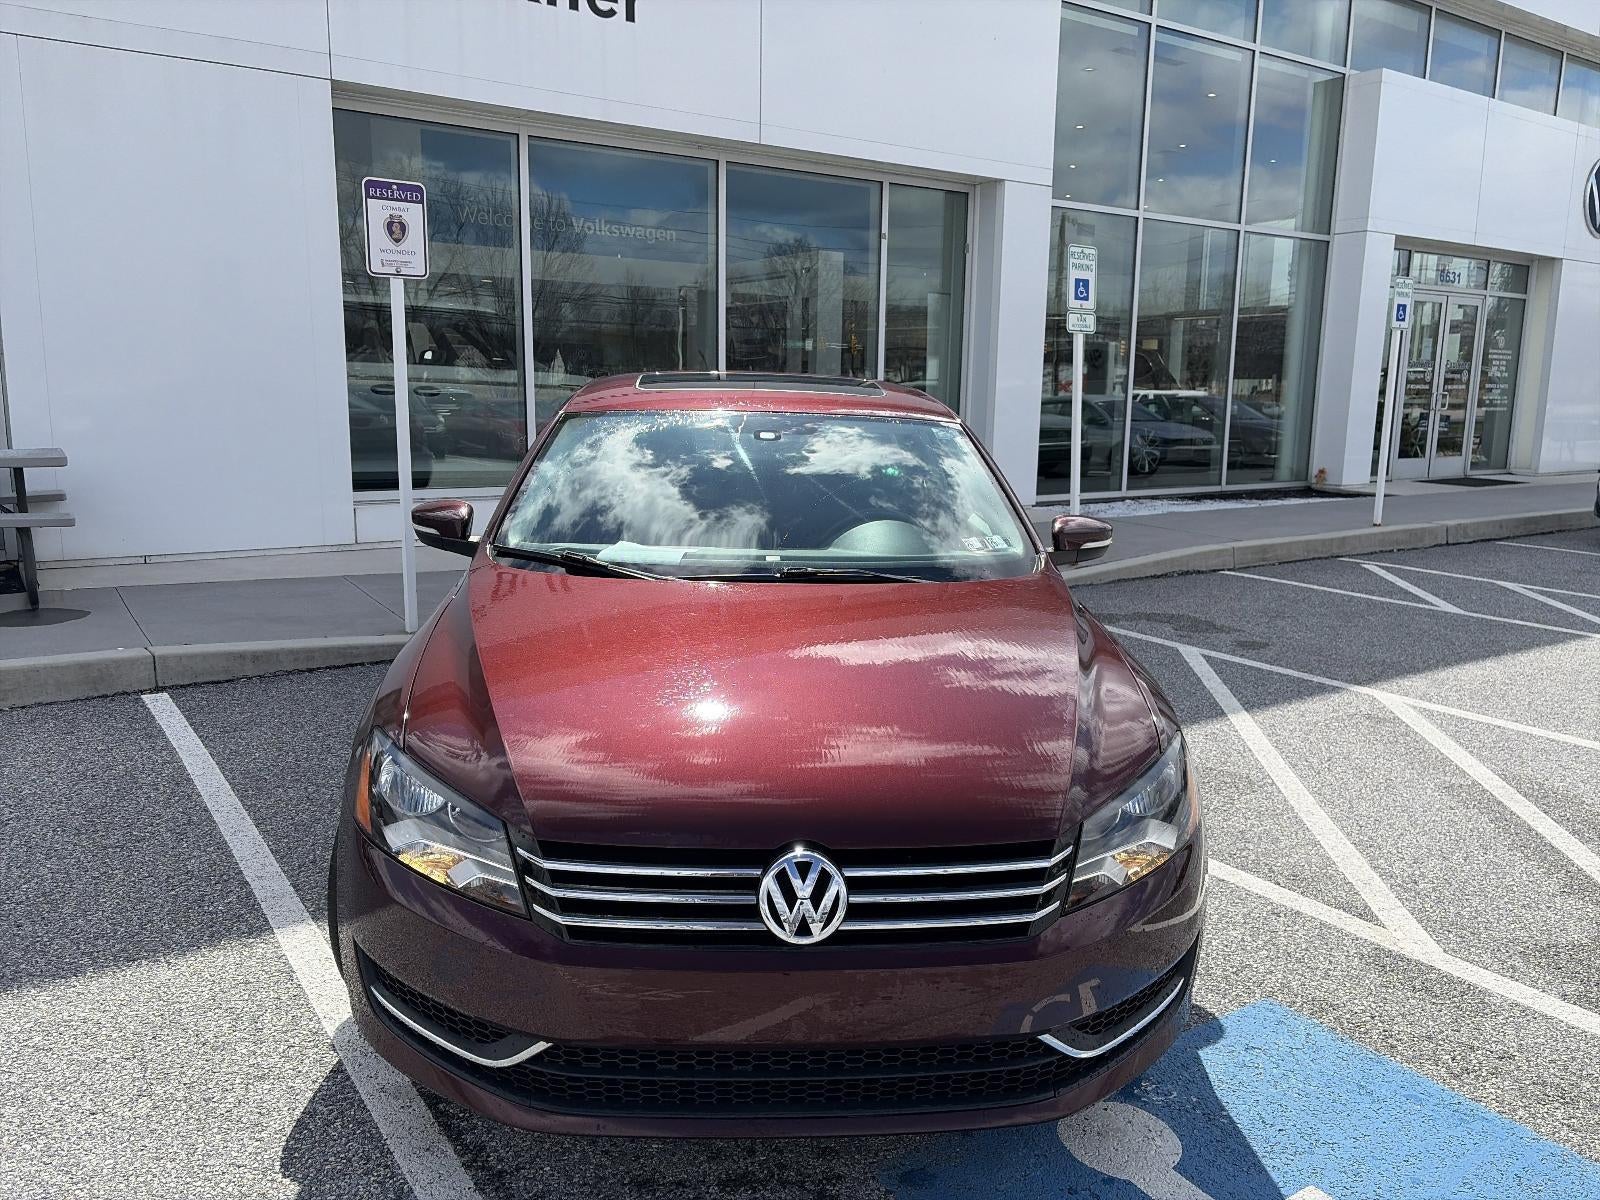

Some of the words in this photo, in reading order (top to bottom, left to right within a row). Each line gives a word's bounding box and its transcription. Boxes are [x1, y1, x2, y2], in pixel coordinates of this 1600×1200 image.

[369, 187, 421, 201] RESERVED
[381, 204, 410, 213] COMBAT
[458, 207, 544, 230] Welcoe
[550, 217, 566, 232] to
[572, 216, 676, 244] Volkswagen
[379, 247, 416, 256] WOUNDED
[1071, 250, 1095, 262] RESERVED
[1071, 262, 1094, 273] PARKING
[1440, 271, 1462, 284] 6631
[1077, 315, 1087, 323] VAN
